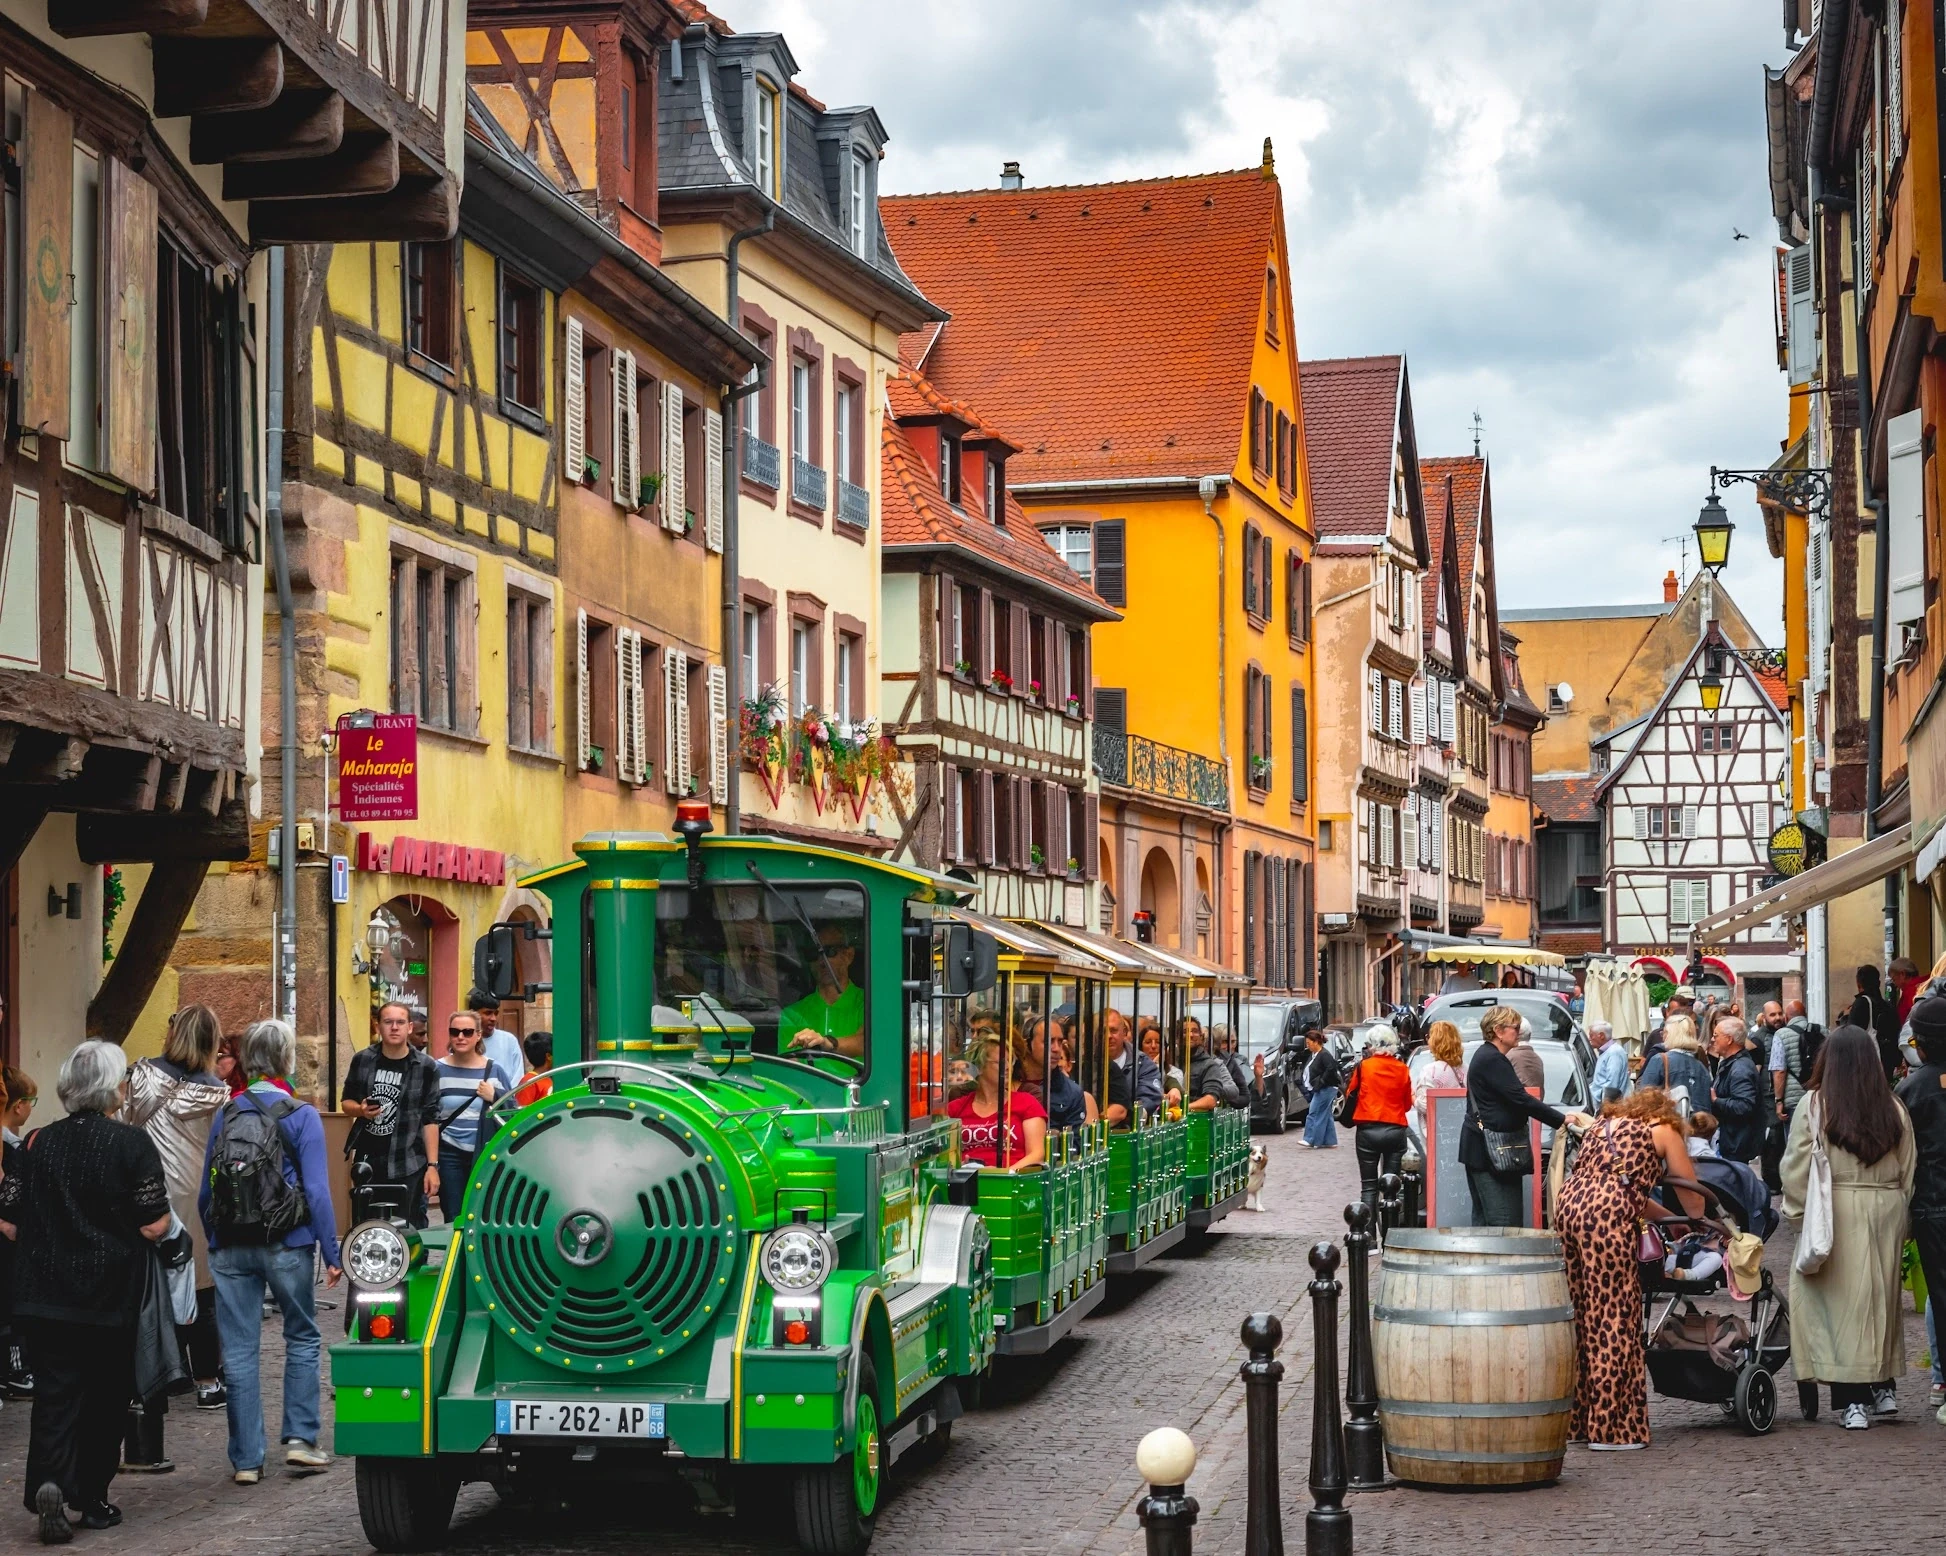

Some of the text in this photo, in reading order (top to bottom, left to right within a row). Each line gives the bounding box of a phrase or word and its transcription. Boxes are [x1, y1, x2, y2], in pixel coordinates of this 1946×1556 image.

[341, 717, 414, 730] RURANT
[366, 735, 384, 752] Le
[341, 758, 414, 779] Maharaja
[352, 781, 404, 794] Spécialités
[354, 795, 403, 805] Indiennes
[360, 810, 370, 818] 03
[371, 809, 381, 818] 89
[382, 809, 391, 818] 41
[393, 809, 402, 817] 70
[404, 808, 414, 817] 95
[1633, 946, 1728, 957] TABACS ESSE
[650, 1421, 664, 1435] 68
